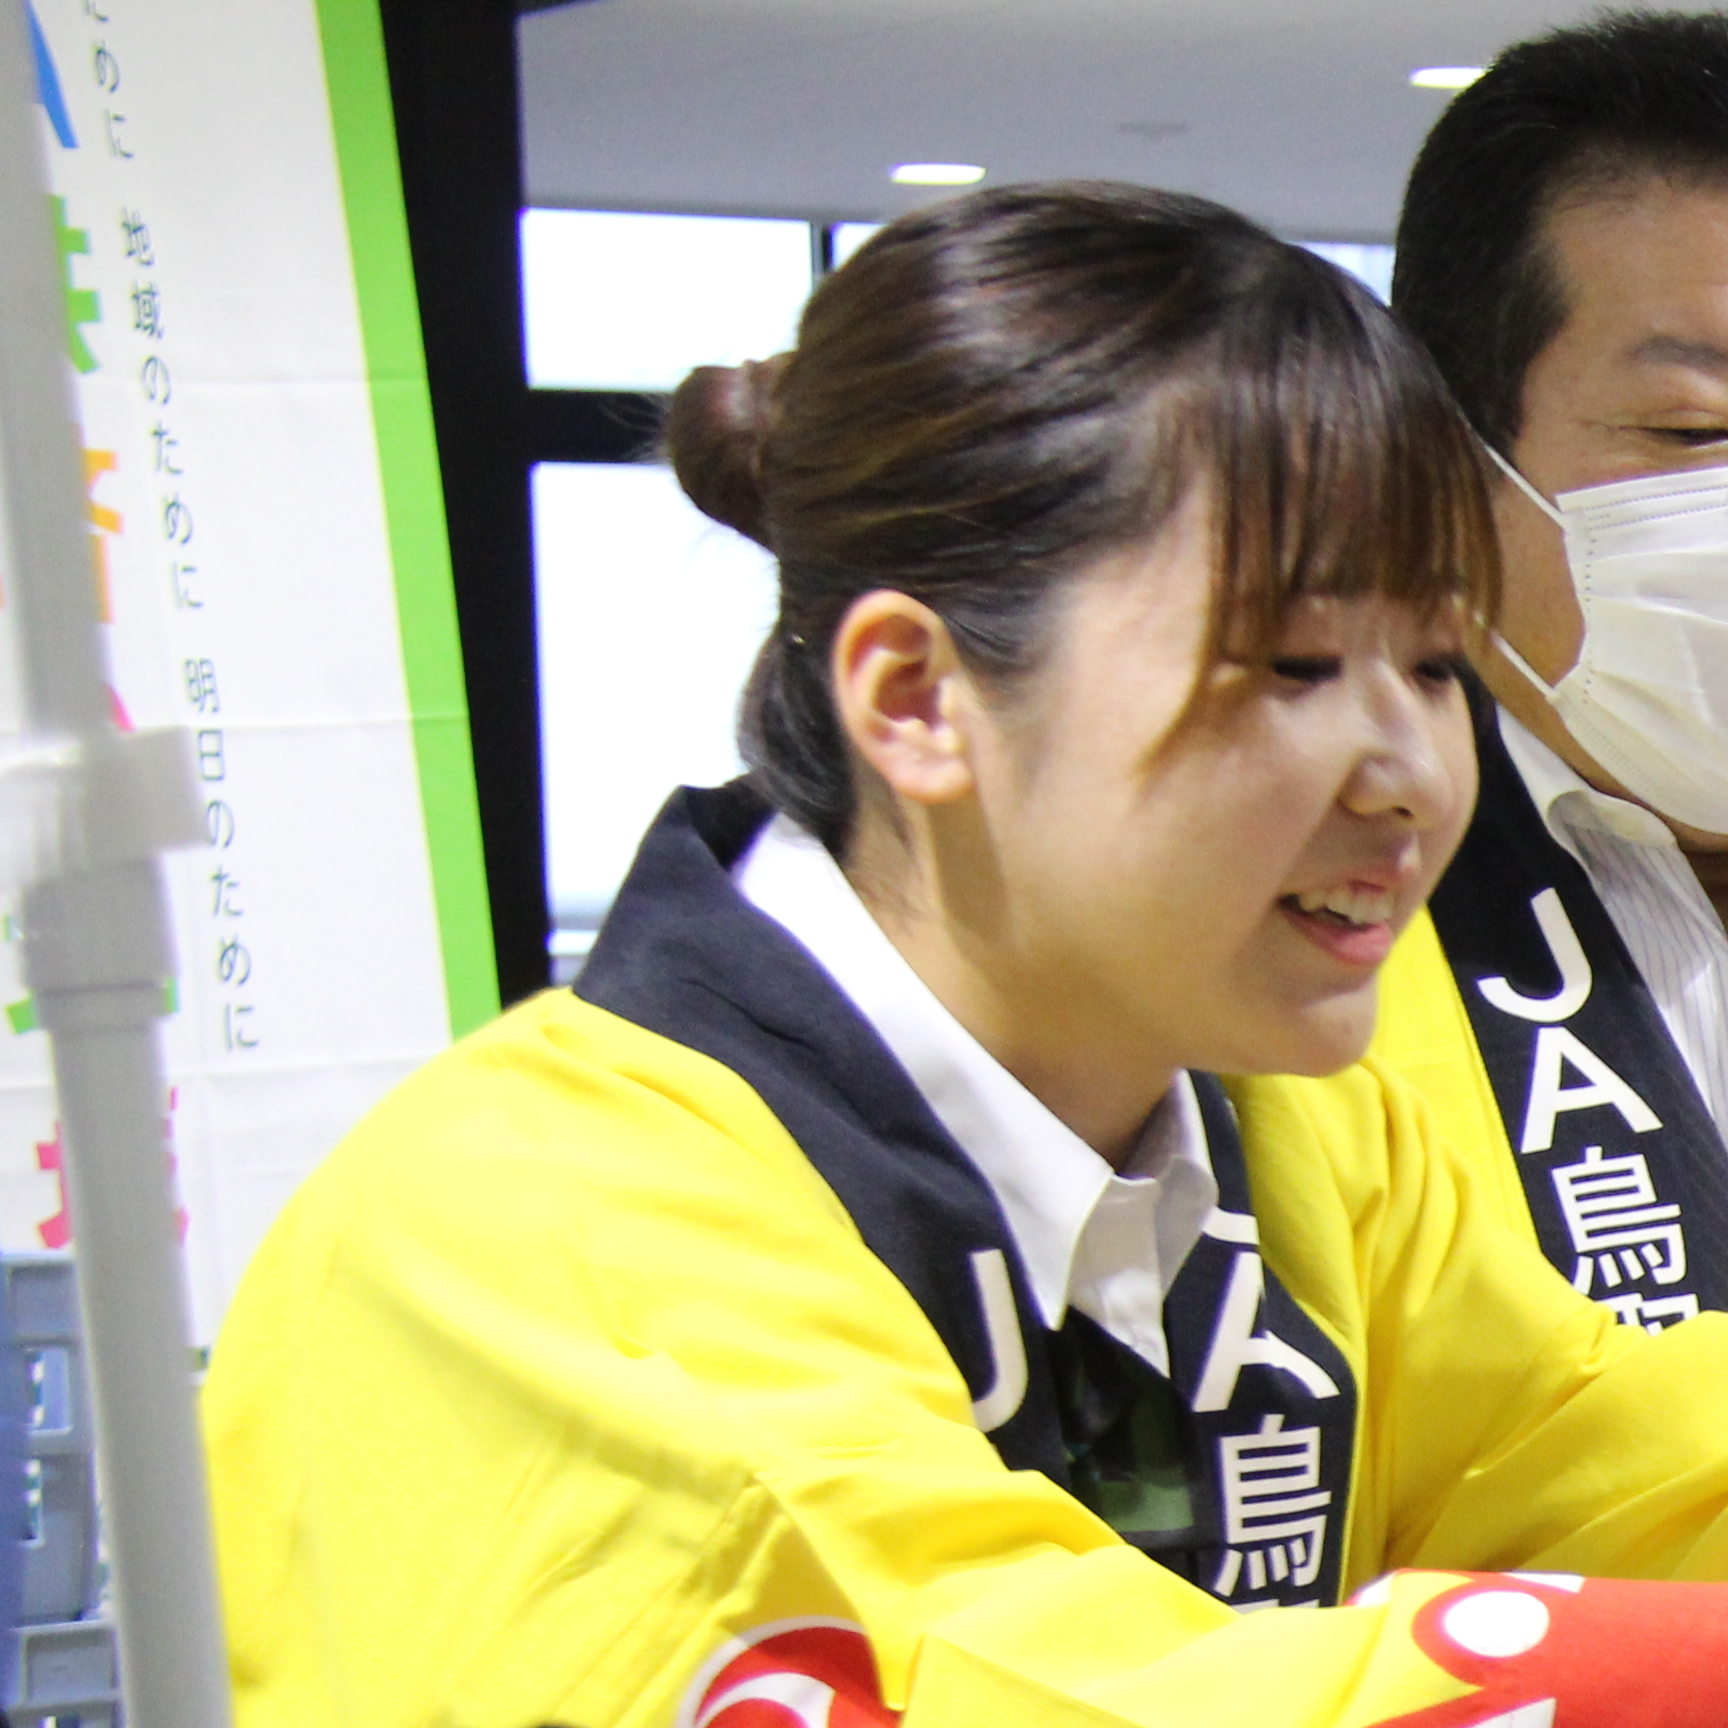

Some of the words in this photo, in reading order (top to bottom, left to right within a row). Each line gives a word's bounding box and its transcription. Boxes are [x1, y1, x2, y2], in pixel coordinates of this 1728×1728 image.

[119, 205, 205, 611] 地域のために
[183, 656, 260, 1053] 明日のために
